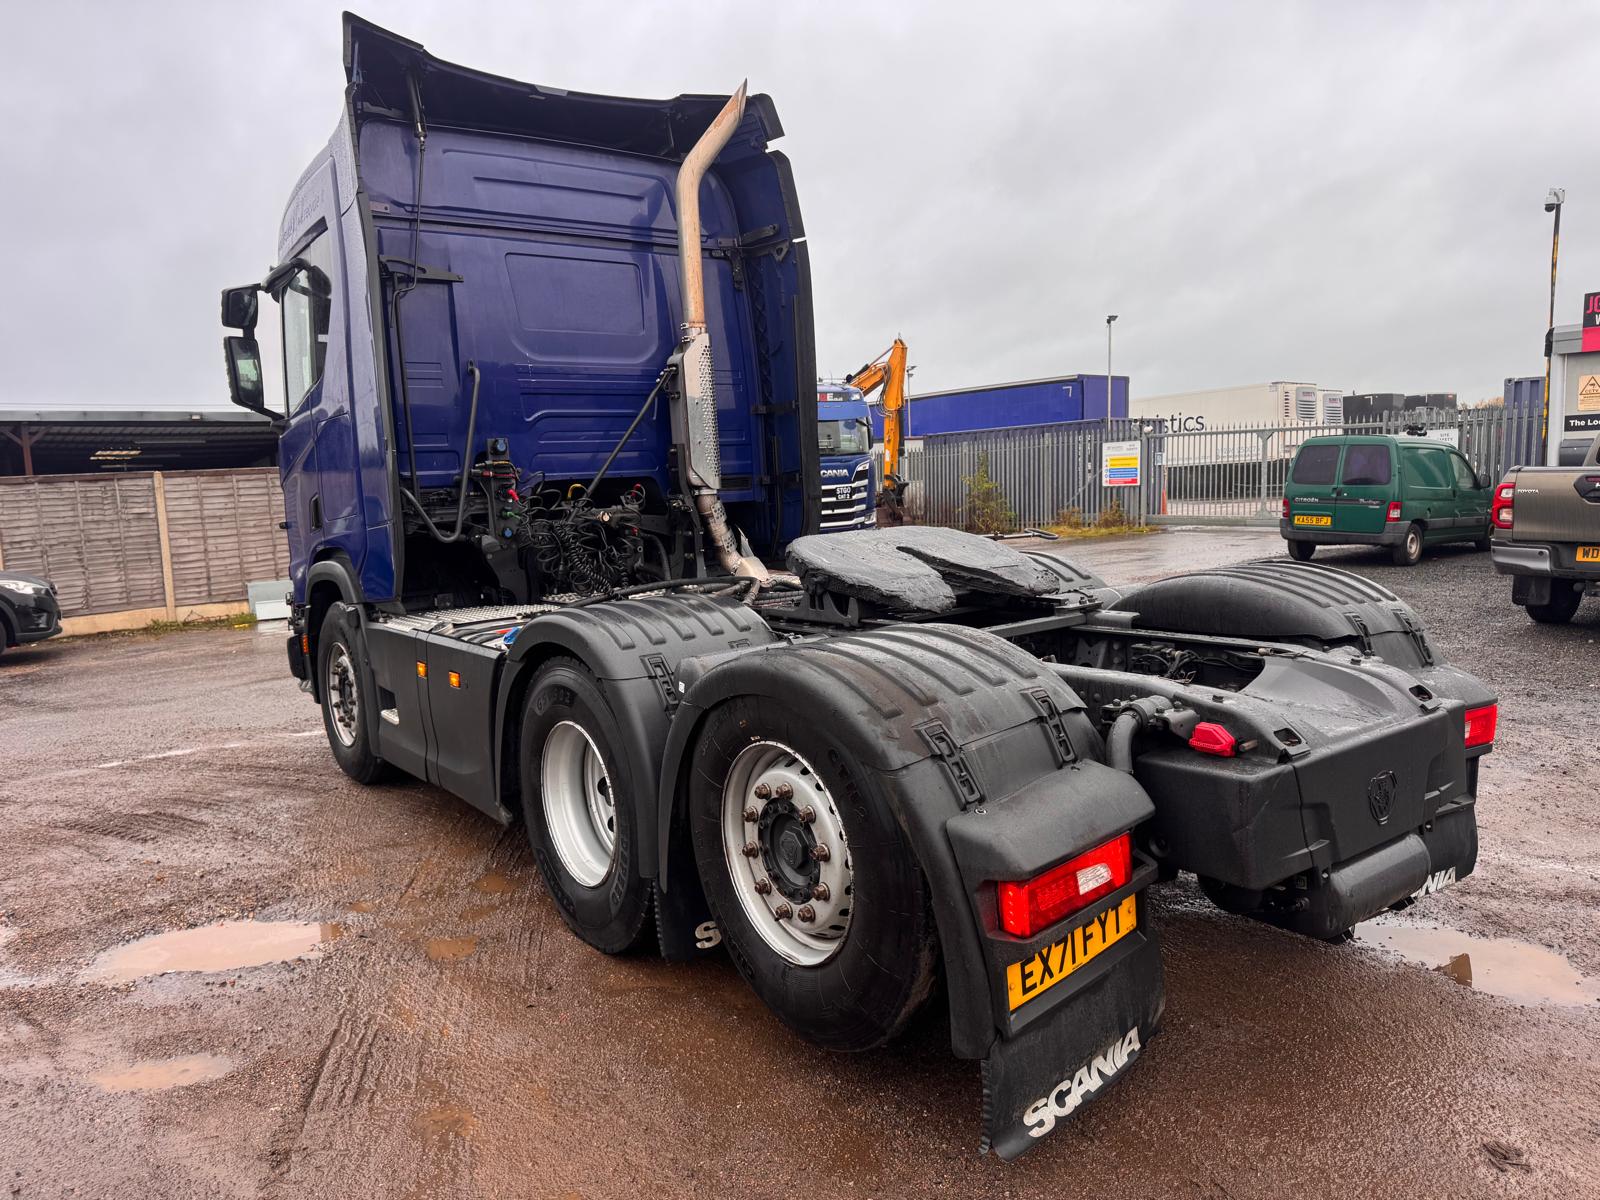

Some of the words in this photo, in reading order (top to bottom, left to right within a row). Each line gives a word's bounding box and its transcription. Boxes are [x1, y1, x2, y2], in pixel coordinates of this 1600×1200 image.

[820, 469, 849, 477] CANIA
[694, 920, 722, 950] S
[1020, 931, 1077, 996] EX71
[1082, 899, 1124, 957] FYT
[1022, 1026, 1141, 1138] SCANIA
